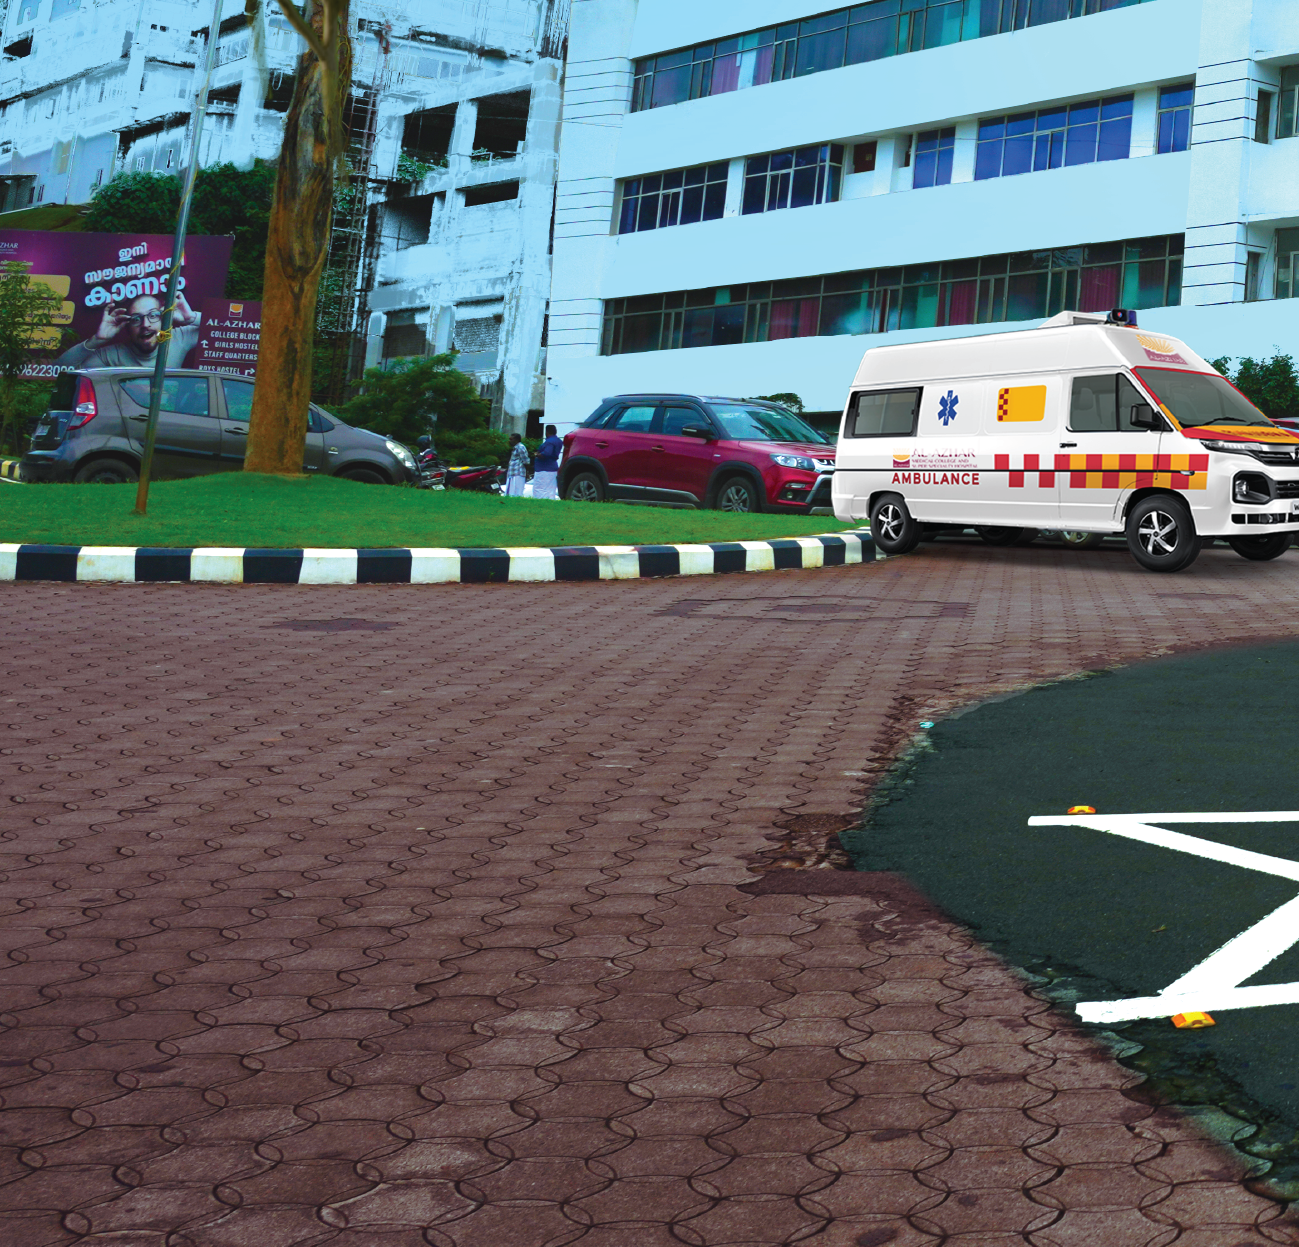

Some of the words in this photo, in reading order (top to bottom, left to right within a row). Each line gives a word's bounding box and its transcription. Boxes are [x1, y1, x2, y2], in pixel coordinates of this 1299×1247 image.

[118, 241, 148, 262] ഇനി
[206, 318, 261, 329] AL-AZHAR
[210, 331, 239, 339] COLLEGE
[240, 332, 260, 340] BLOCK
[215, 341, 234, 349] GIRLS
[235, 342, 259, 350] HOSTEL
[224, 352, 258, 360] QUARTERS
[891, 472, 980, 485] AMBULANCE
